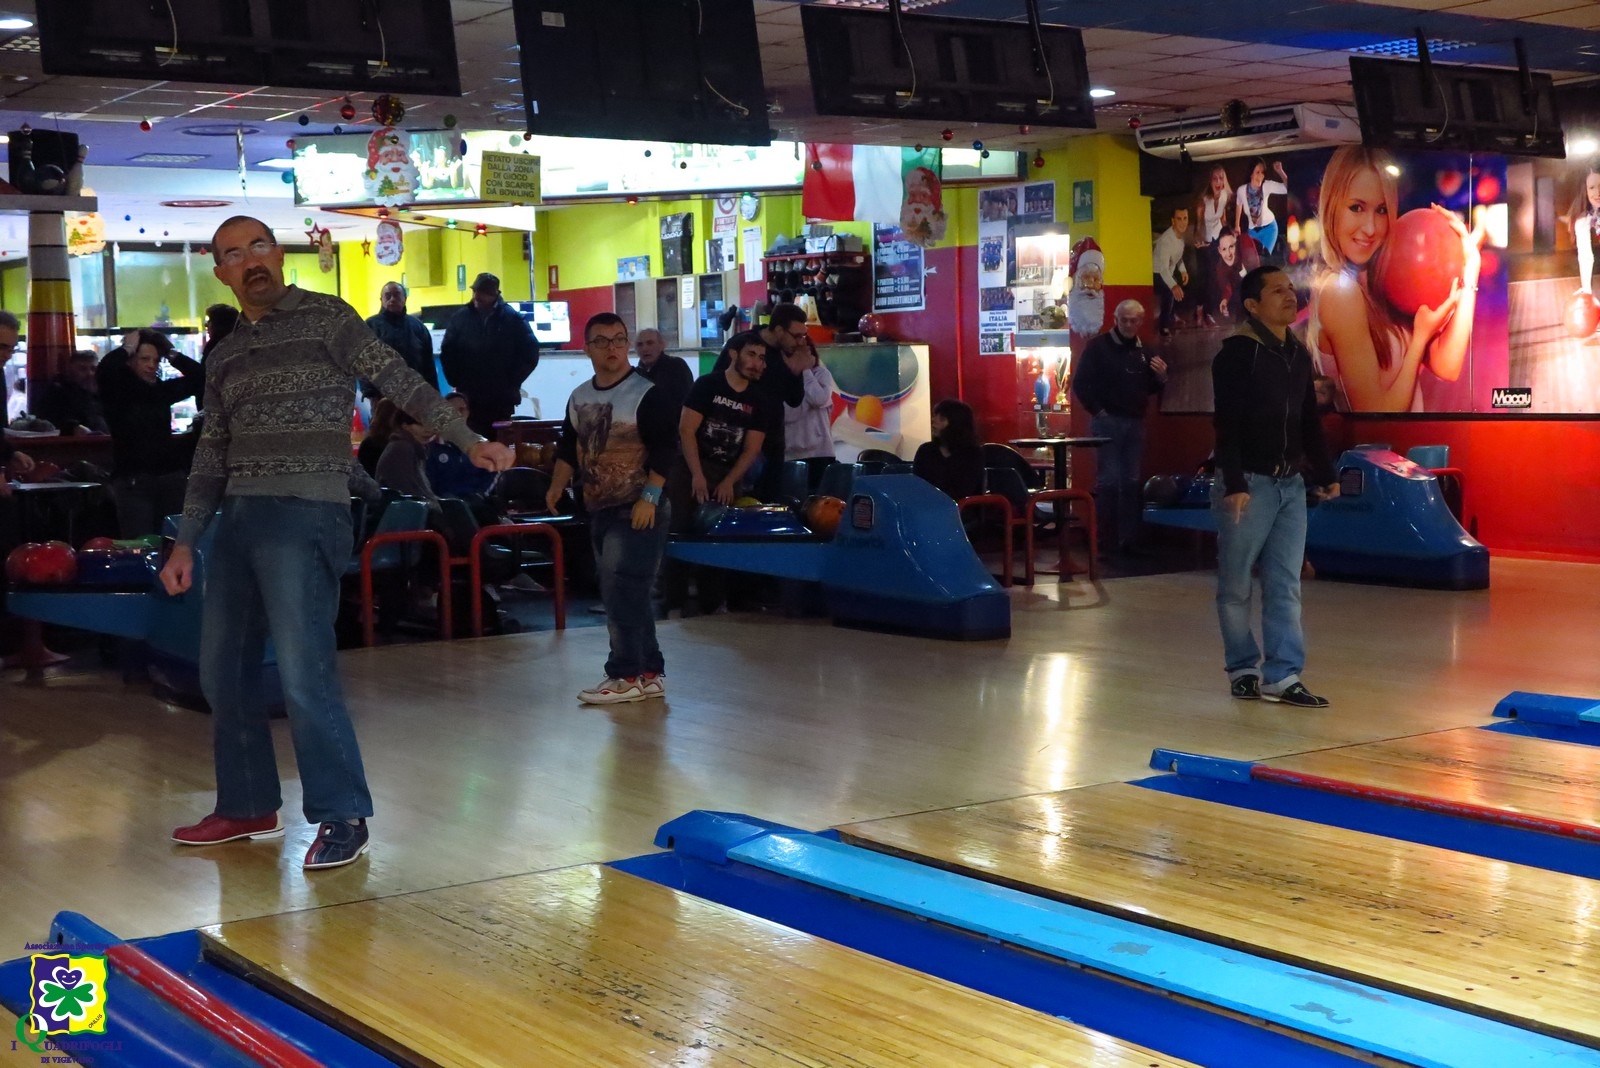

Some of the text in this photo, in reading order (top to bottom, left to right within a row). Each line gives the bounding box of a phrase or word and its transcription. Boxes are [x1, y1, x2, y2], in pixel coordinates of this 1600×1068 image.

[487, 163, 534, 173] DALLA ZONA
[503, 173, 528, 181] GIOCO
[486, 179, 535, 190] CON SCARPE
[499, 189, 535, 198] BOWLING
[713, 395, 743, 411] MAFIA
